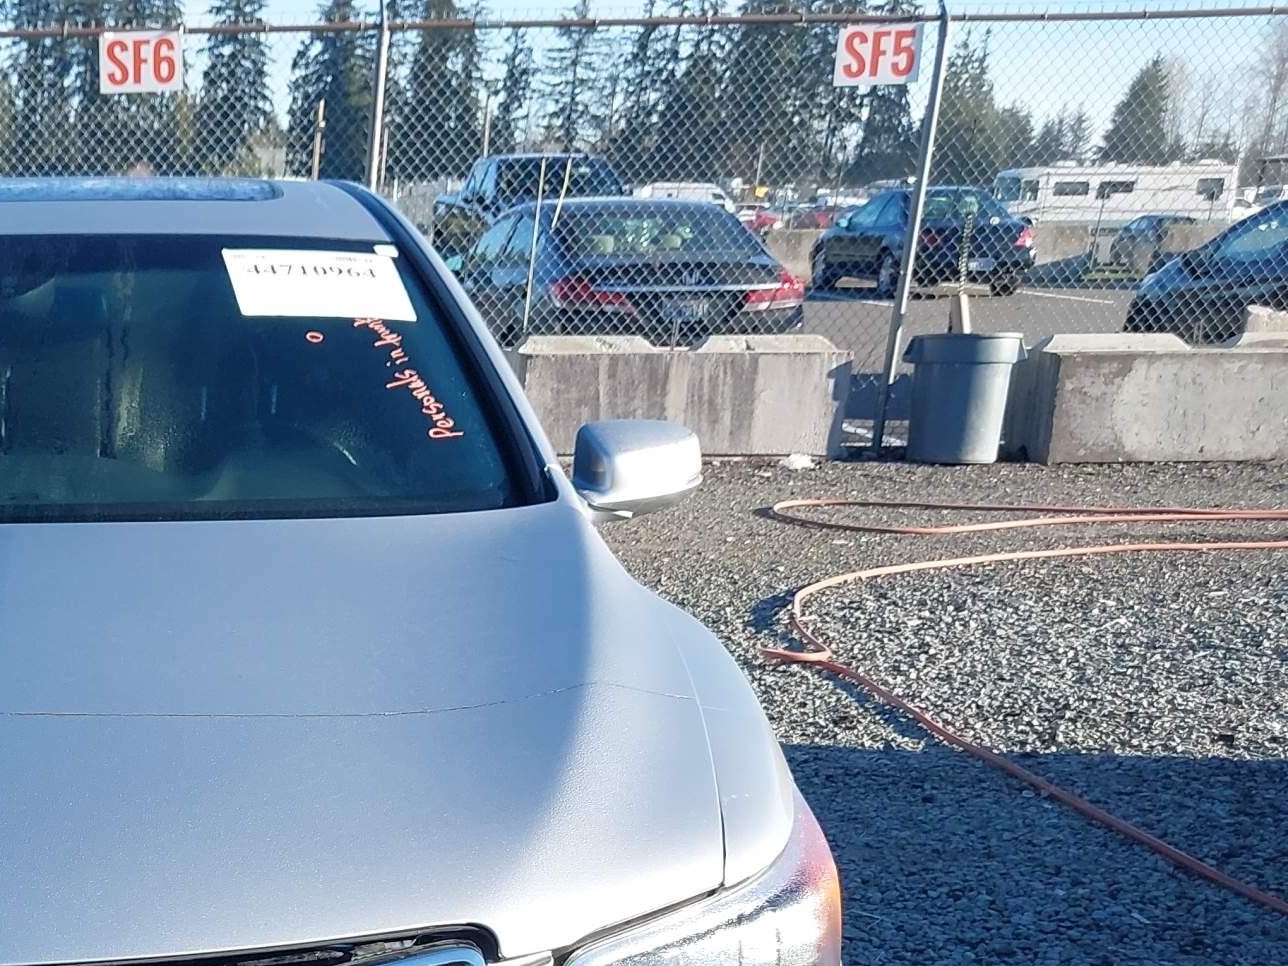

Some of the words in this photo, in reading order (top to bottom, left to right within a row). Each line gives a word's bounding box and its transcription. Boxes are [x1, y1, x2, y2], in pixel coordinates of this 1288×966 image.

[106, 38, 176, 86] SF6
[842, 29, 916, 79] SF5
[386, 347, 409, 367] in
[385, 368, 464, 438] Personals
